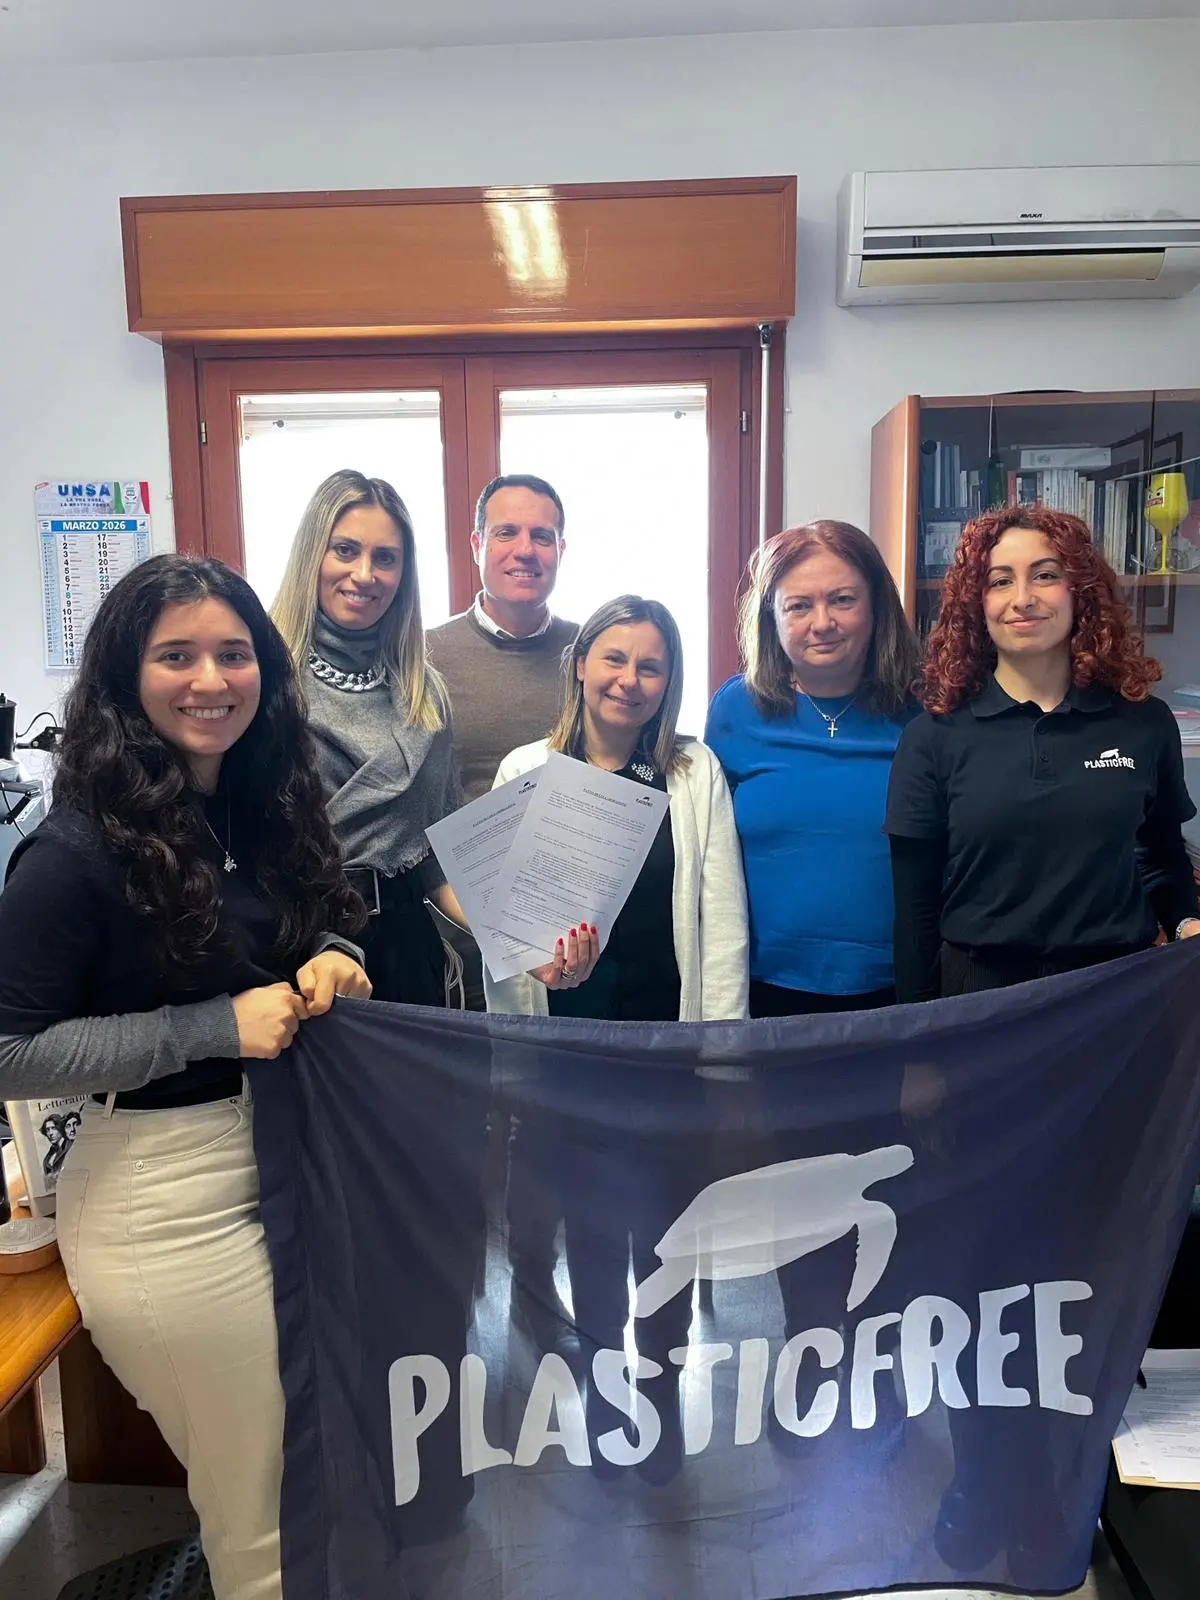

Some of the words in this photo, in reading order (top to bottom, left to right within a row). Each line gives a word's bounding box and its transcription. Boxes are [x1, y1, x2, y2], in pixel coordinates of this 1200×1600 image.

[58, 484, 110, 496] UNSA
[63, 521, 99, 530] MARZO
[102, 521, 126, 530] 2026
[62, 542, 68, 550] 2
[388, 1281, 1094, 1507] PLASTICFREE
